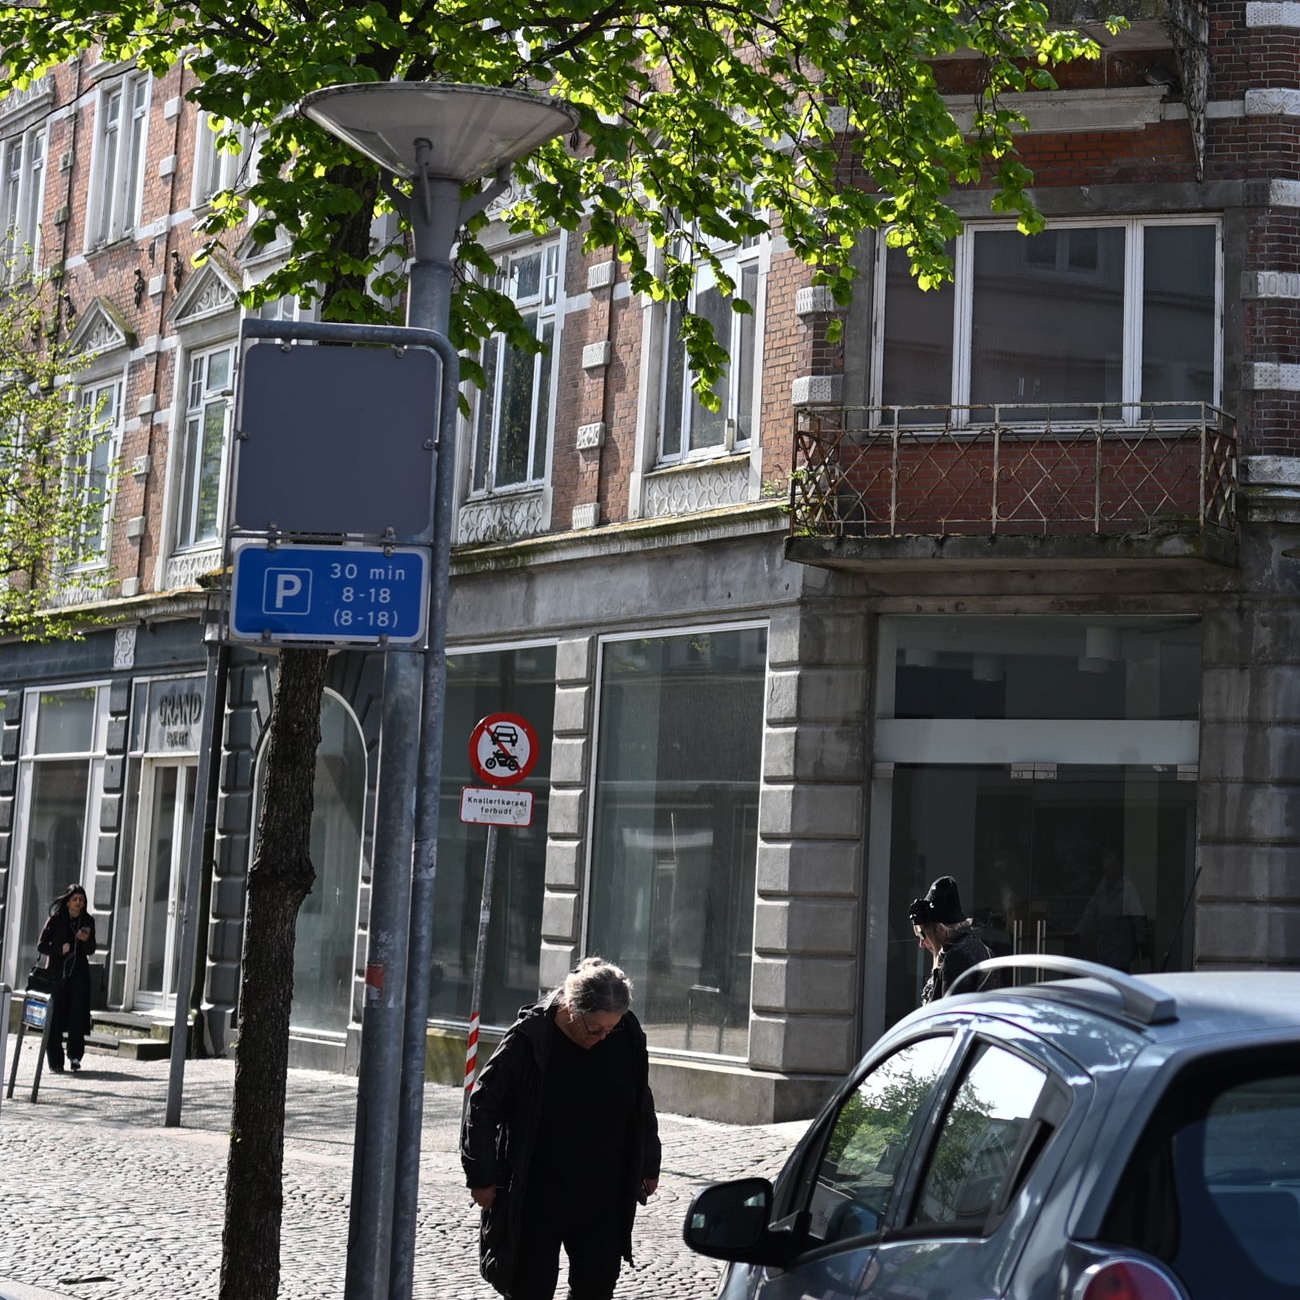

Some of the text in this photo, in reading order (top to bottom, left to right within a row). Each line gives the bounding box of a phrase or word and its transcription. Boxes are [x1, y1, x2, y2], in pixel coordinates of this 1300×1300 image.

[330, 563, 405, 580] 30 min
[275, 574, 302, 608] P
[159, 692, 202, 728] GRAND
[467, 796, 527, 807] Knallertkørsel
[480, 806, 512, 815] forbudt
